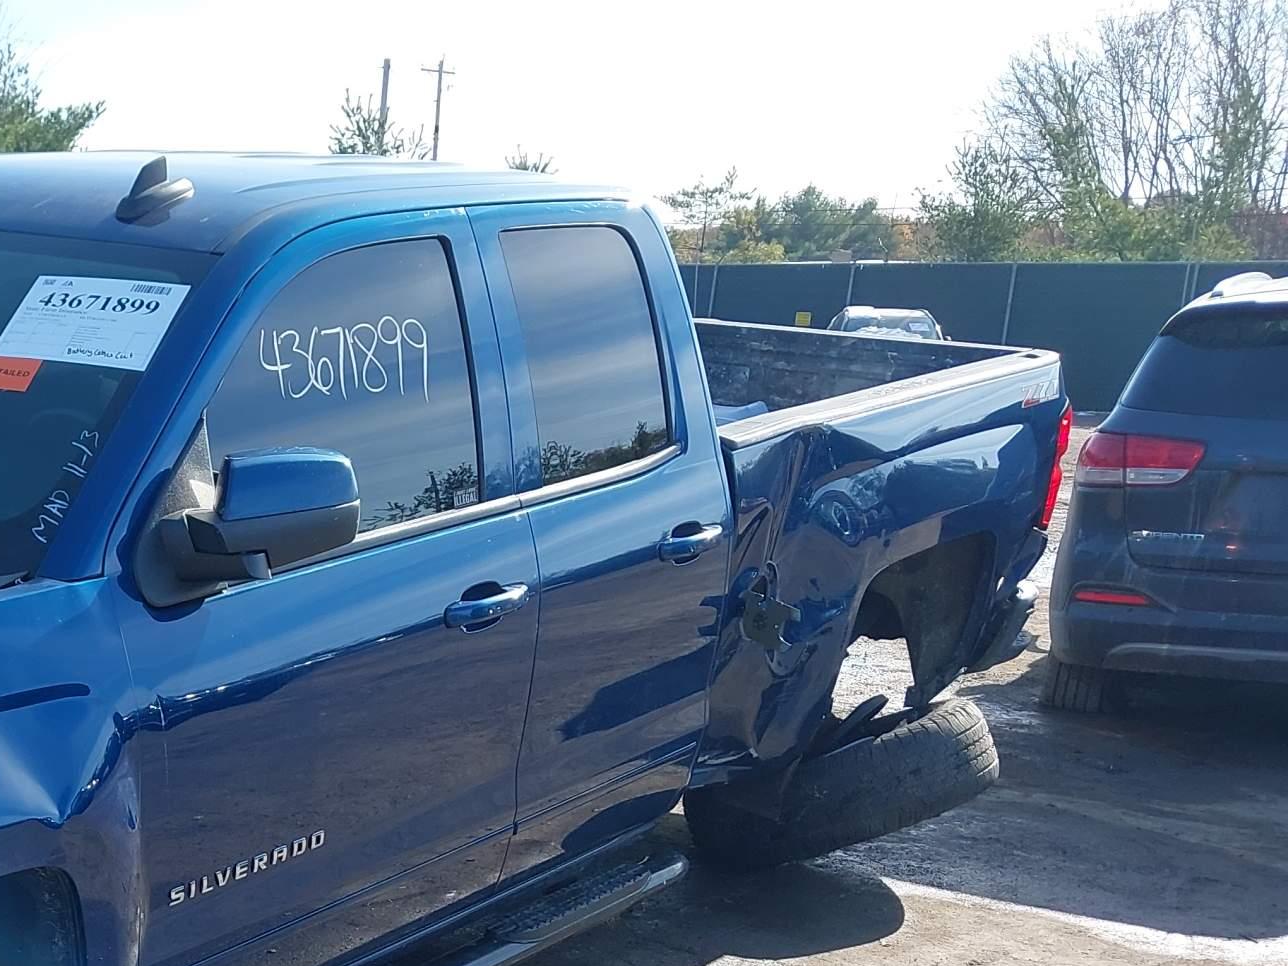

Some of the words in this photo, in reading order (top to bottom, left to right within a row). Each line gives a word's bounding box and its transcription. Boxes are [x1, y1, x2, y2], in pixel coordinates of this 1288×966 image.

[38, 291, 161, 315] 43671899
[259, 315, 430, 403] 43671899
[31, 489, 70, 544] MAD
[62, 429, 99, 478] 11-13
[167, 829, 326, 907] SILVERADO
